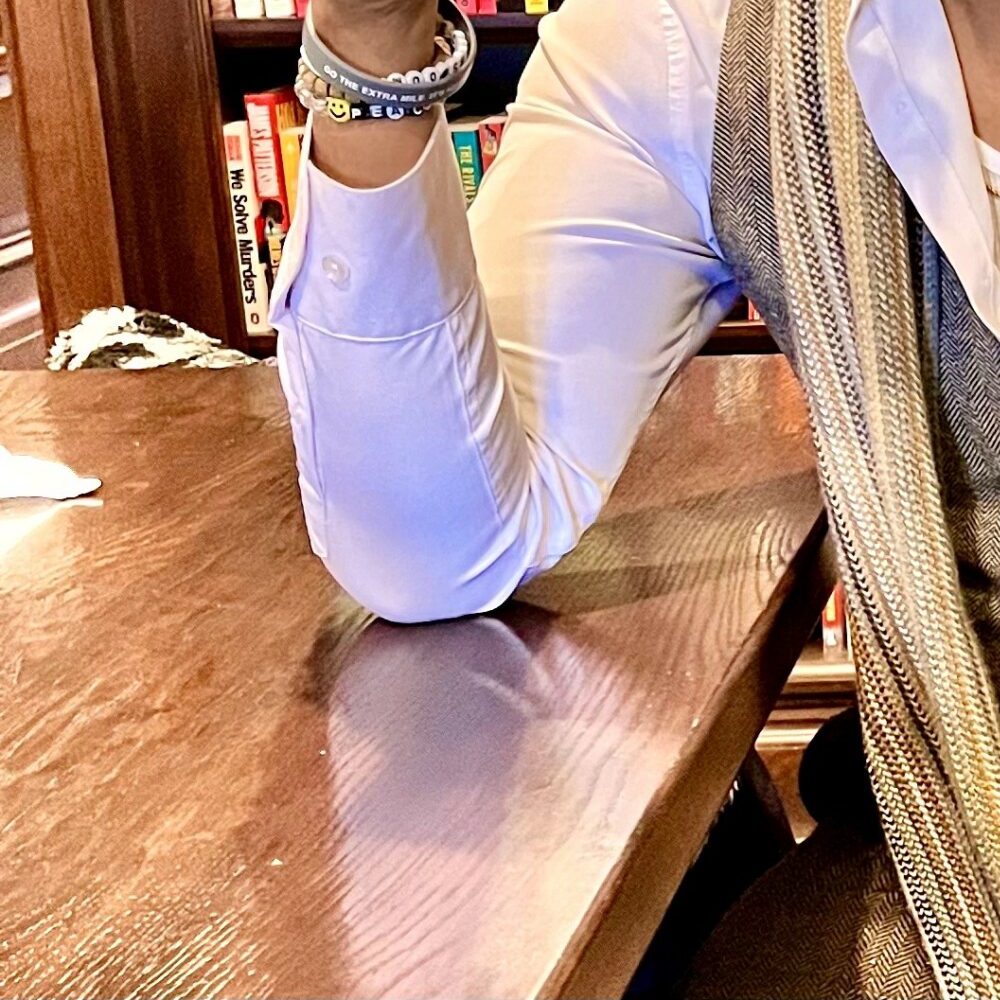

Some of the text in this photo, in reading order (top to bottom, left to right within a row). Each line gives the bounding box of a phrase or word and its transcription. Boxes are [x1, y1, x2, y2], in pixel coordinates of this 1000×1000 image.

[339, 75, 360, 92] THE
[361, 86, 398, 102] EXTRA
[229, 167, 257, 305] We Solve Murders
